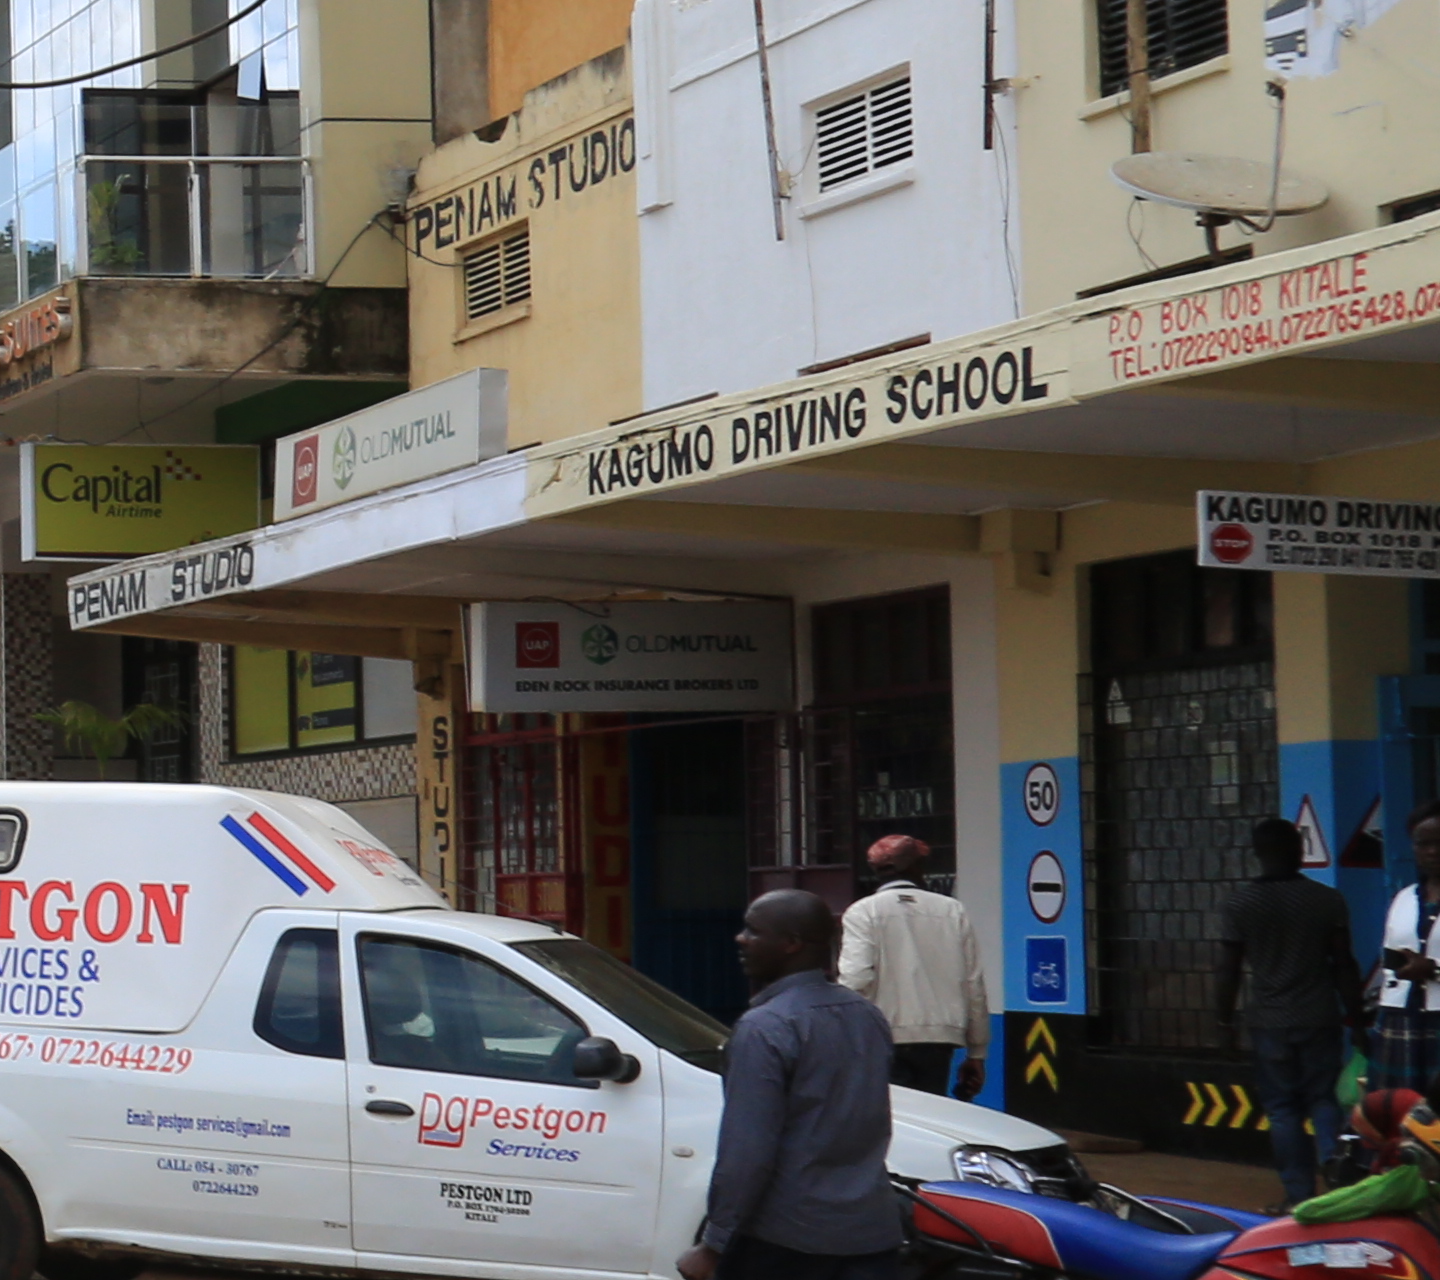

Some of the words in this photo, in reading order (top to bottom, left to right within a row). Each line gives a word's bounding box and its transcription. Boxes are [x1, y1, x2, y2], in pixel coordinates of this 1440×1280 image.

[412, 172, 517, 257] PENAM
[528, 118, 636, 209] STUDIO
[1160, 296, 1208, 334] BOX
[1221, 281, 1263, 320] 1018
[1279, 253, 1368, 311] KITALE
[588, 424, 714, 496] KAGUMO
[732, 387, 867, 465] DRIVING
[886, 346, 1048, 424] SCHOOL
[41, 463, 162, 513] Capital
[106, 505, 162, 518] Airtime
[1207, 496, 1327, 526] KAGUMO
[1214, 538, 1249, 548] STOP
[1269, 529, 1307, 542] P.O.
[1316, 531, 1361, 545] BOX
[1369, 534, 1421, 548] 1018
[74, 570, 146, 624] PENAM
[171, 545, 254, 601] STUDIO
[526, 640, 551, 650] UAP
[516, 681, 549, 692] EDEN
[553, 681, 591, 692] ROCK
[595, 680, 669, 692] INSURANCE
[675, 679, 733, 691] BROKERS
[737, 679, 759, 691] LTD
[1029, 781, 1054, 808] 50
[79, 949, 100, 983] &
[40, 1036, 193, 1074] 0722644229
[127, 1108, 155, 1127] Email:
[157, 1113, 194, 1134] pestgon
[469, 1098, 607, 1139] Pestgon
[486, 1139, 581, 1163] Services
[157, 1158, 192, 1172] CALL:
[195, 1161, 215, 1174] 054
[226, 1163, 259, 1177] 30767
[193, 1180, 259, 1196] 0722644229
[440, 1182, 503, 1203] PESTGON
[506, 1190, 533, 1206] LTD
[465, 1212, 498, 1223] KITALE
